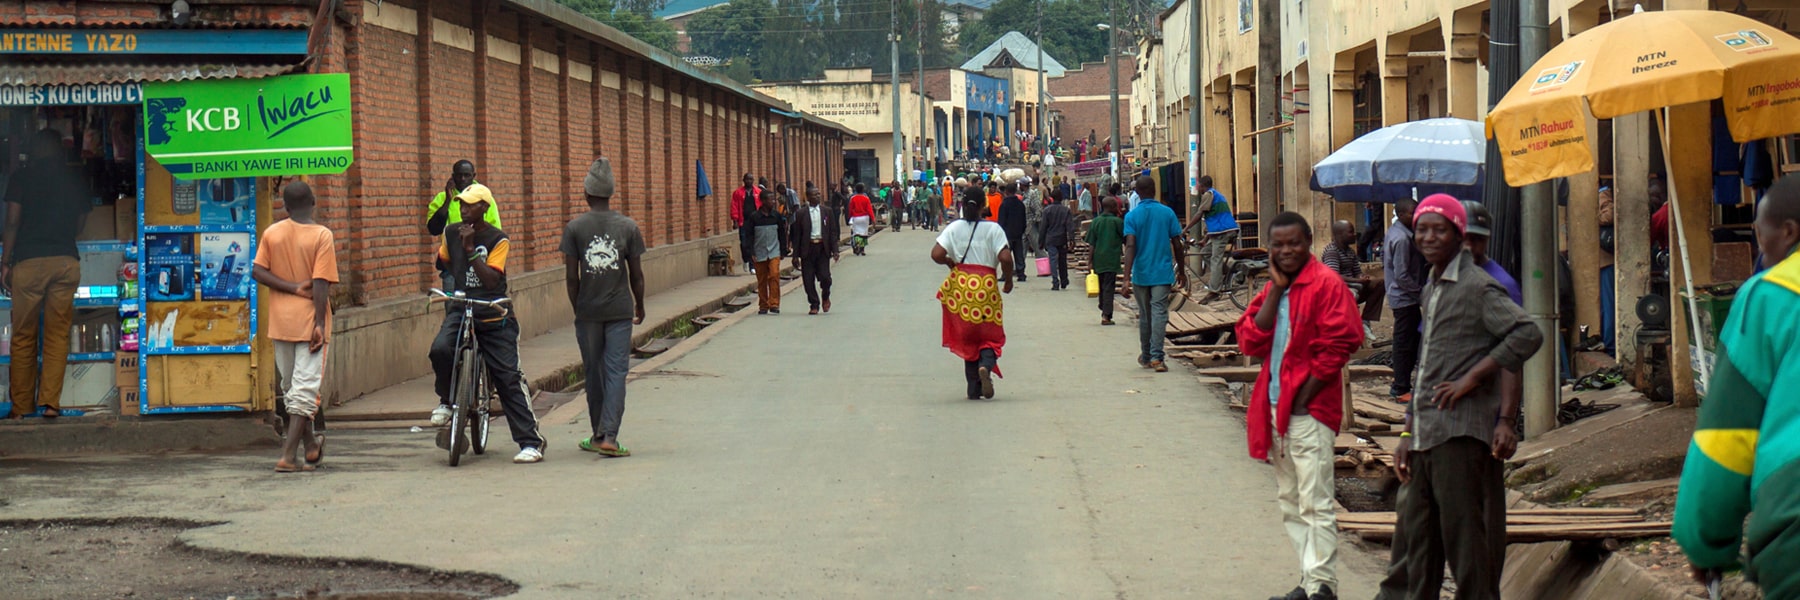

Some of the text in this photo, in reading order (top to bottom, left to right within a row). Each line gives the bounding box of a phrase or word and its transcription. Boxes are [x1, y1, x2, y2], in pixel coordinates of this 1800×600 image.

[0, 33, 137, 51] NTENNE YAZO
[1637, 50, 1666, 63] MTN
[48, 86, 69, 104] KU
[71, 84, 122, 104] GICIRO
[186, 85, 333, 132] KCB Iwacu
[195, 156, 348, 173] BANKI YAWE IRI HANO
